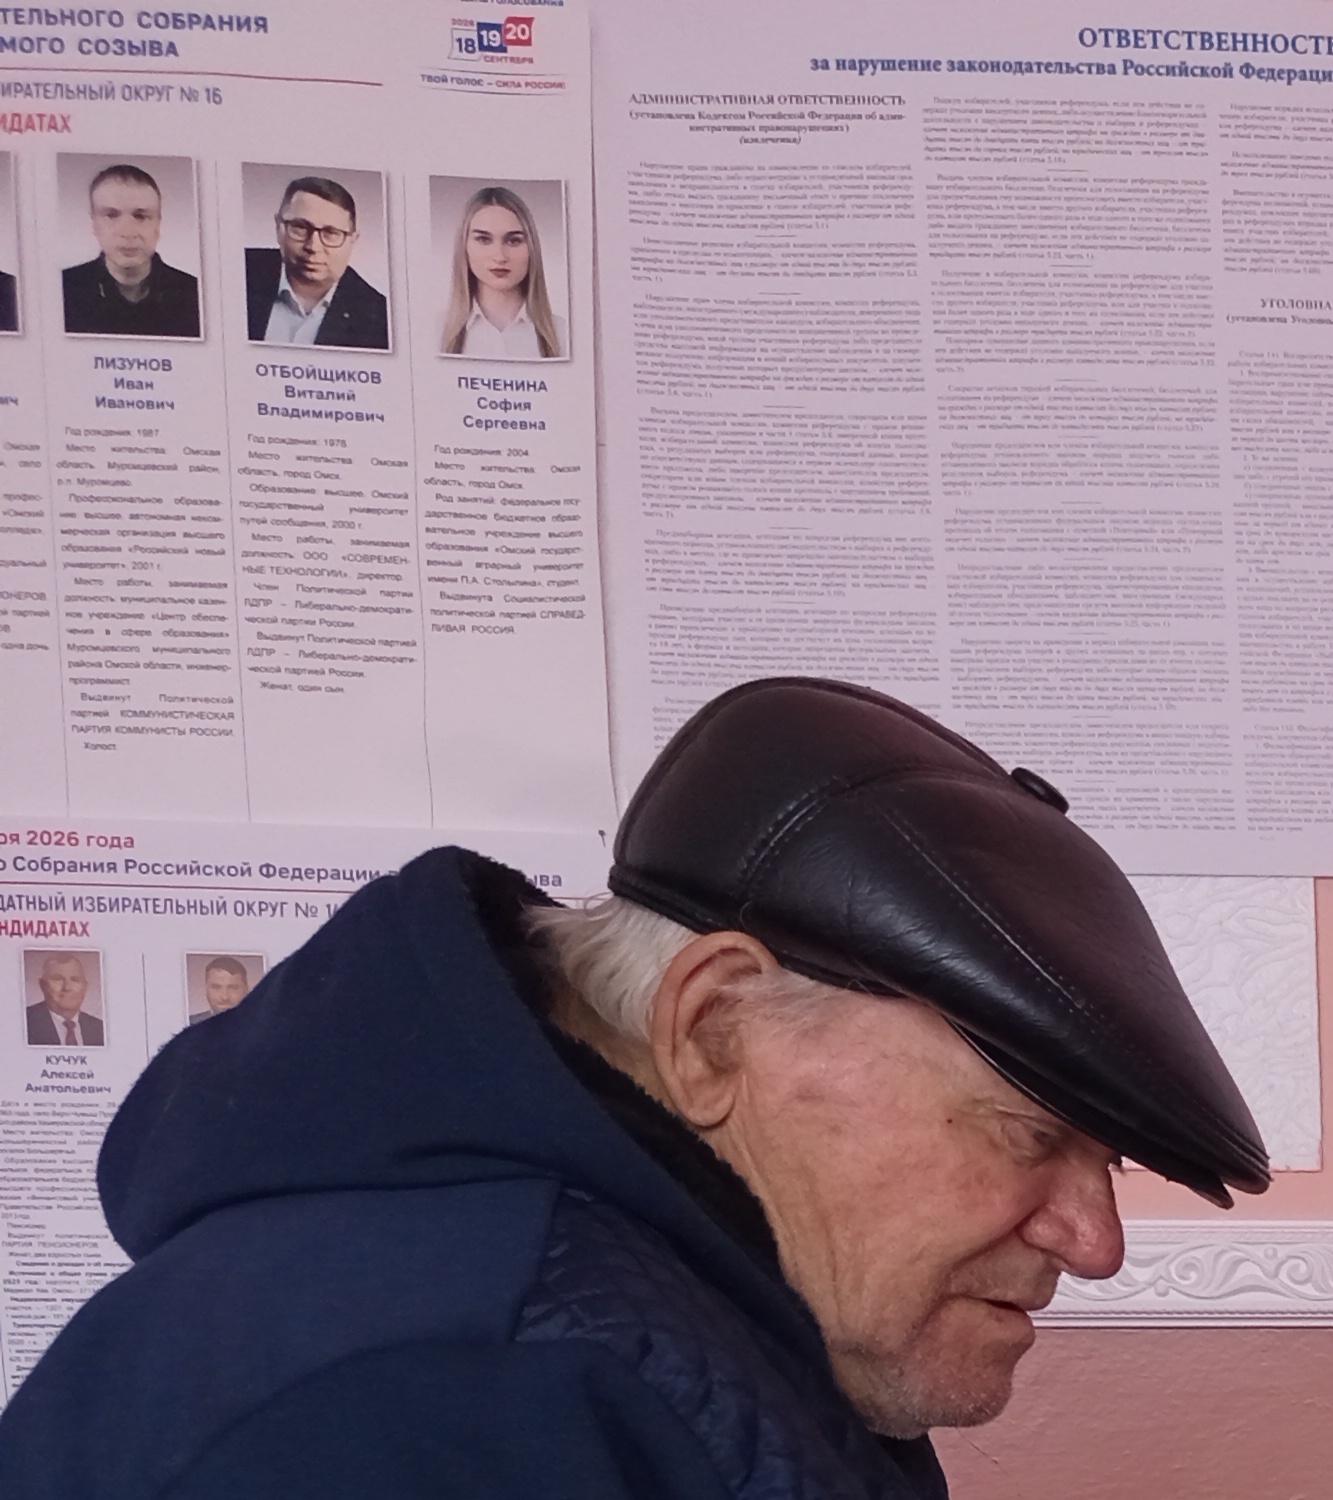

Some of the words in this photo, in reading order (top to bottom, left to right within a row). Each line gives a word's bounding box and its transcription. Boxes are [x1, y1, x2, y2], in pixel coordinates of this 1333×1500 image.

[0, 8, 124, 28] ТЕЛЬНОГО
[137, 11, 268, 33] СОБРАНИЯ
[456, 38, 476, 54] 18
[480, 30, 500, 47] 19
[505, 24, 529, 40] 20
[78, 39, 179, 57] СОЗЫВА
[483, 55, 534, 64] СЕНТЯБРЯ
[810, 57, 831, 72] за
[835, 56, 942, 77] нарушение
[946, 58, 1117, 76] законодательства
[1121, 58, 1234, 80] Российской
[421, 74, 448, 84] ТВОЙ
[451, 77, 484, 87] ГОЛОС
[495, 80, 521, 88] СИЛА
[121, 85, 174, 102] ОКРУГ
[180, 86, 199, 102] №
[204, 88, 222, 105] 16
[629, 94, 775, 105] АДМИНИСТРАТИВНАЯ
[777, 94, 906, 106] ОТВЕТСТВЕННОСТЬ
[93, 356, 173, 371] ЛИЗУНОВ
[255, 363, 382, 384] ОТБОЙЩИКОВ
[113, 377, 154, 390] Иван
[457, 376, 548, 393] ПЕЧЕНИНА
[284, 385, 356, 401] Виталий
[95, 395, 175, 410] Иванович
[476, 397, 531, 413] София
[257, 402, 385, 423] Владимирович
[462, 415, 546, 431] Сергеевна
[244, 598, 273, 608] ЛДПР
[247, 647, 276, 658] ЛДПР
[71, 725, 111, 734] ПАРТИЯ
[114, 726, 186, 736] КОММУНИСТЫ
[26, 830, 79, 847] 2026
[86, 835, 135, 849] года
[13, 856, 117, 875] Собрания
[124, 858, 252, 878] Российской
[259, 862, 380, 883] Федерации
[72, 895, 228, 917] ИЗБИРАТЕЛЬНЫЙ
[233, 899, 288, 918] ОКРУГ
[294, 901, 319, 918] №
[327, 902, 338, 918] 1
[45, 1055, 88, 1065] КУЧУК
[41, 1069, 94, 1080] Алексей
[25, 1083, 112, 1094] Анатольевич
